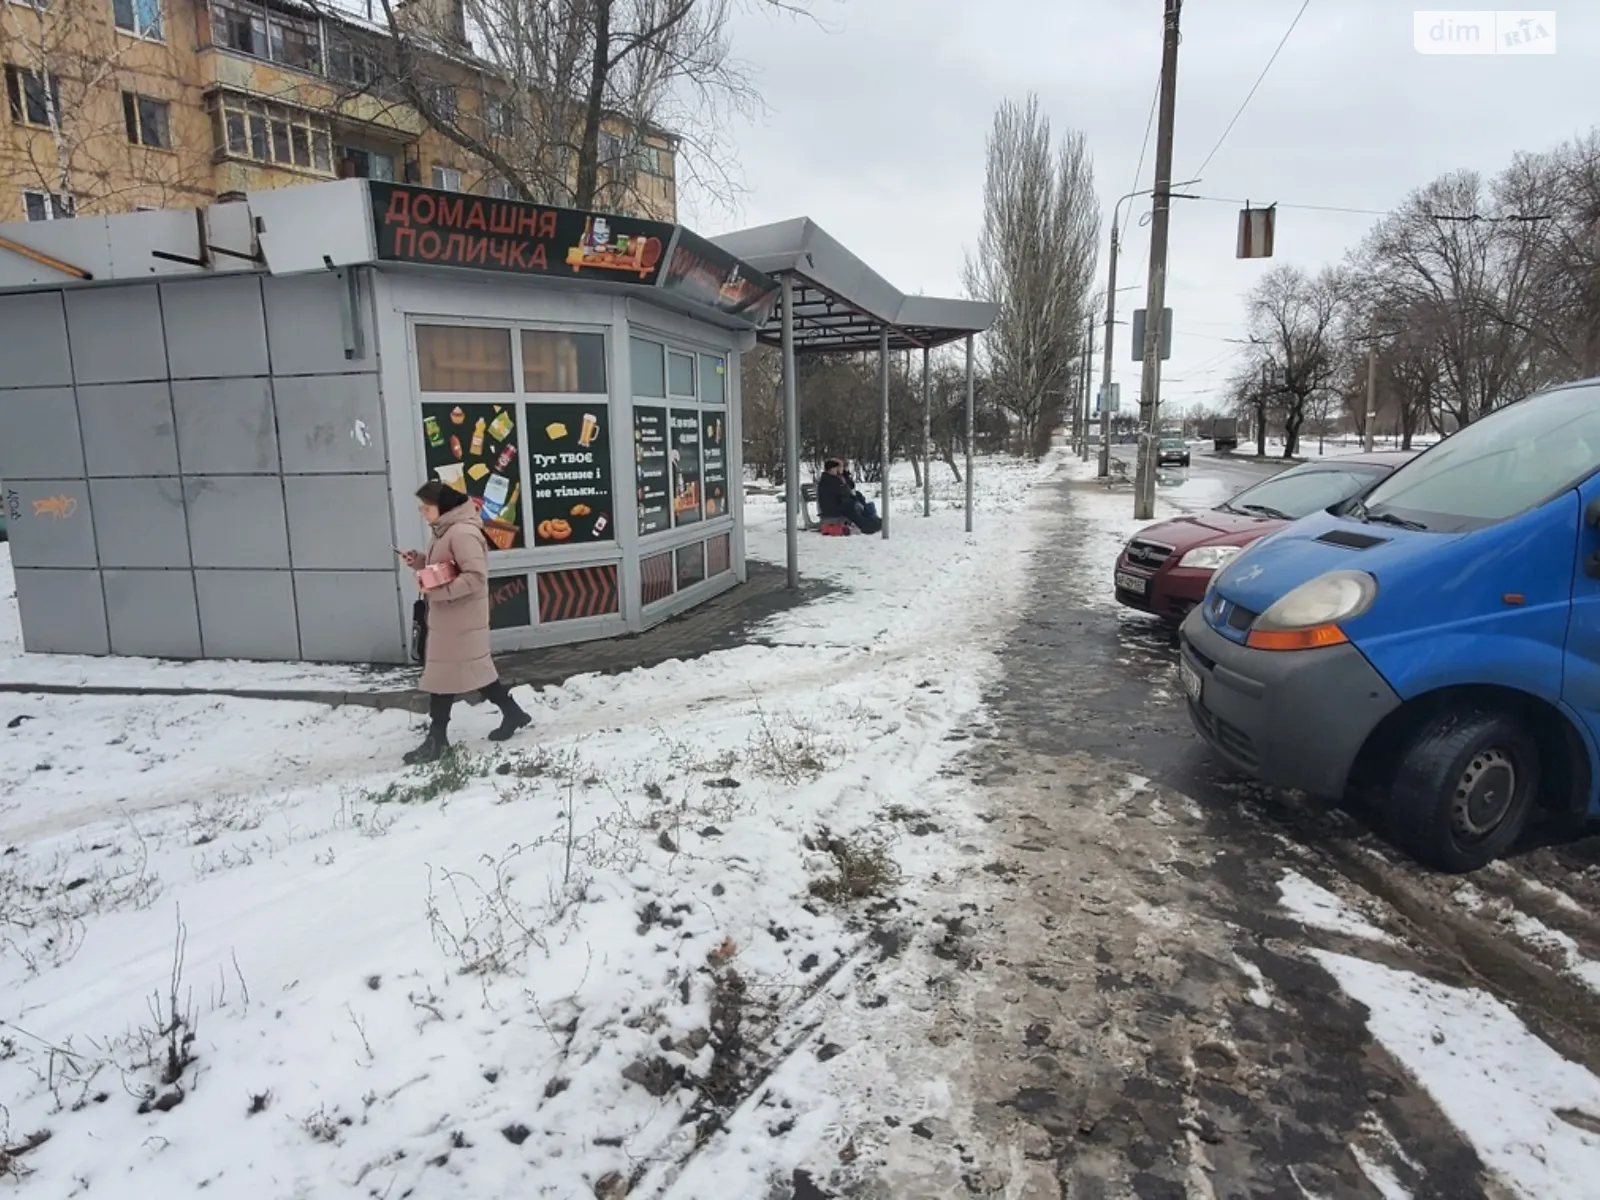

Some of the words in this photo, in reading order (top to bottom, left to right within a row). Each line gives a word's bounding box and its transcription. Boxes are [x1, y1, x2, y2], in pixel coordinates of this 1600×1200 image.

[385, 189, 558, 238] ДОМАШНЯ
[394, 227, 548, 270] ПОЛИЧКА
[533, 453, 557, 468] Тут
[535, 470, 594, 485] розливне
[595, 467, 601, 479] і
[536, 488, 552, 498] не
